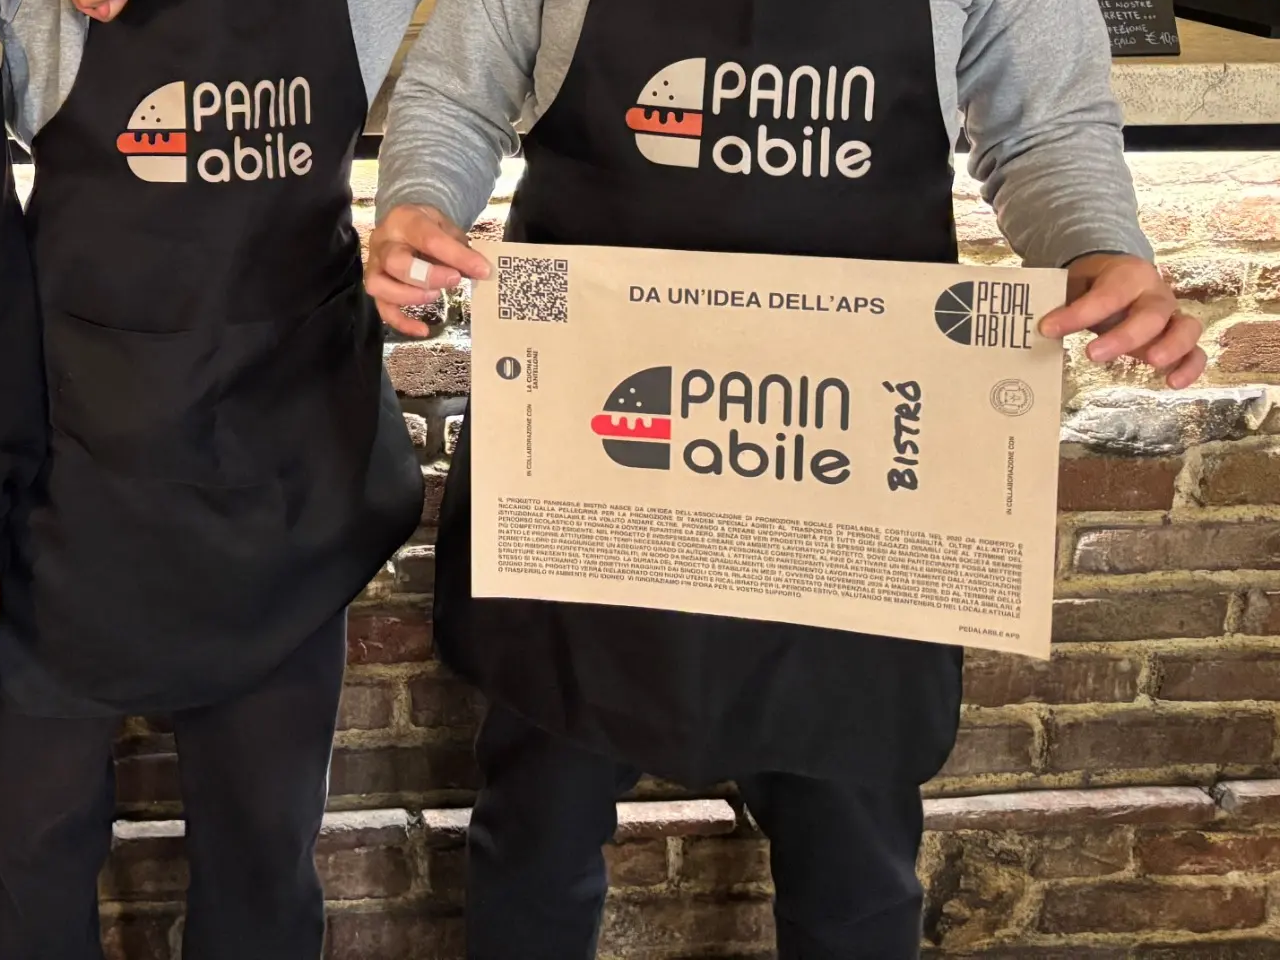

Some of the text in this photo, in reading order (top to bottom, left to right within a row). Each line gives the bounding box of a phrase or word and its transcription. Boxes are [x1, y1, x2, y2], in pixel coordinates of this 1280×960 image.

[1116, 0, 1153, 8] NOSTRE
[193, 76, 311, 132] PANIN
[711, 61, 875, 121] PANIN
[197, 132, 313, 183] abile
[712, 124, 872, 178] abile
[628, 286, 886, 315] DA UN'IDEA DELL'APS
[976, 281, 1034, 317] PEDAL
[975, 315, 1034, 349] ABILE
[680, 369, 850, 431] PANIN
[682, 428, 851, 485] abile
